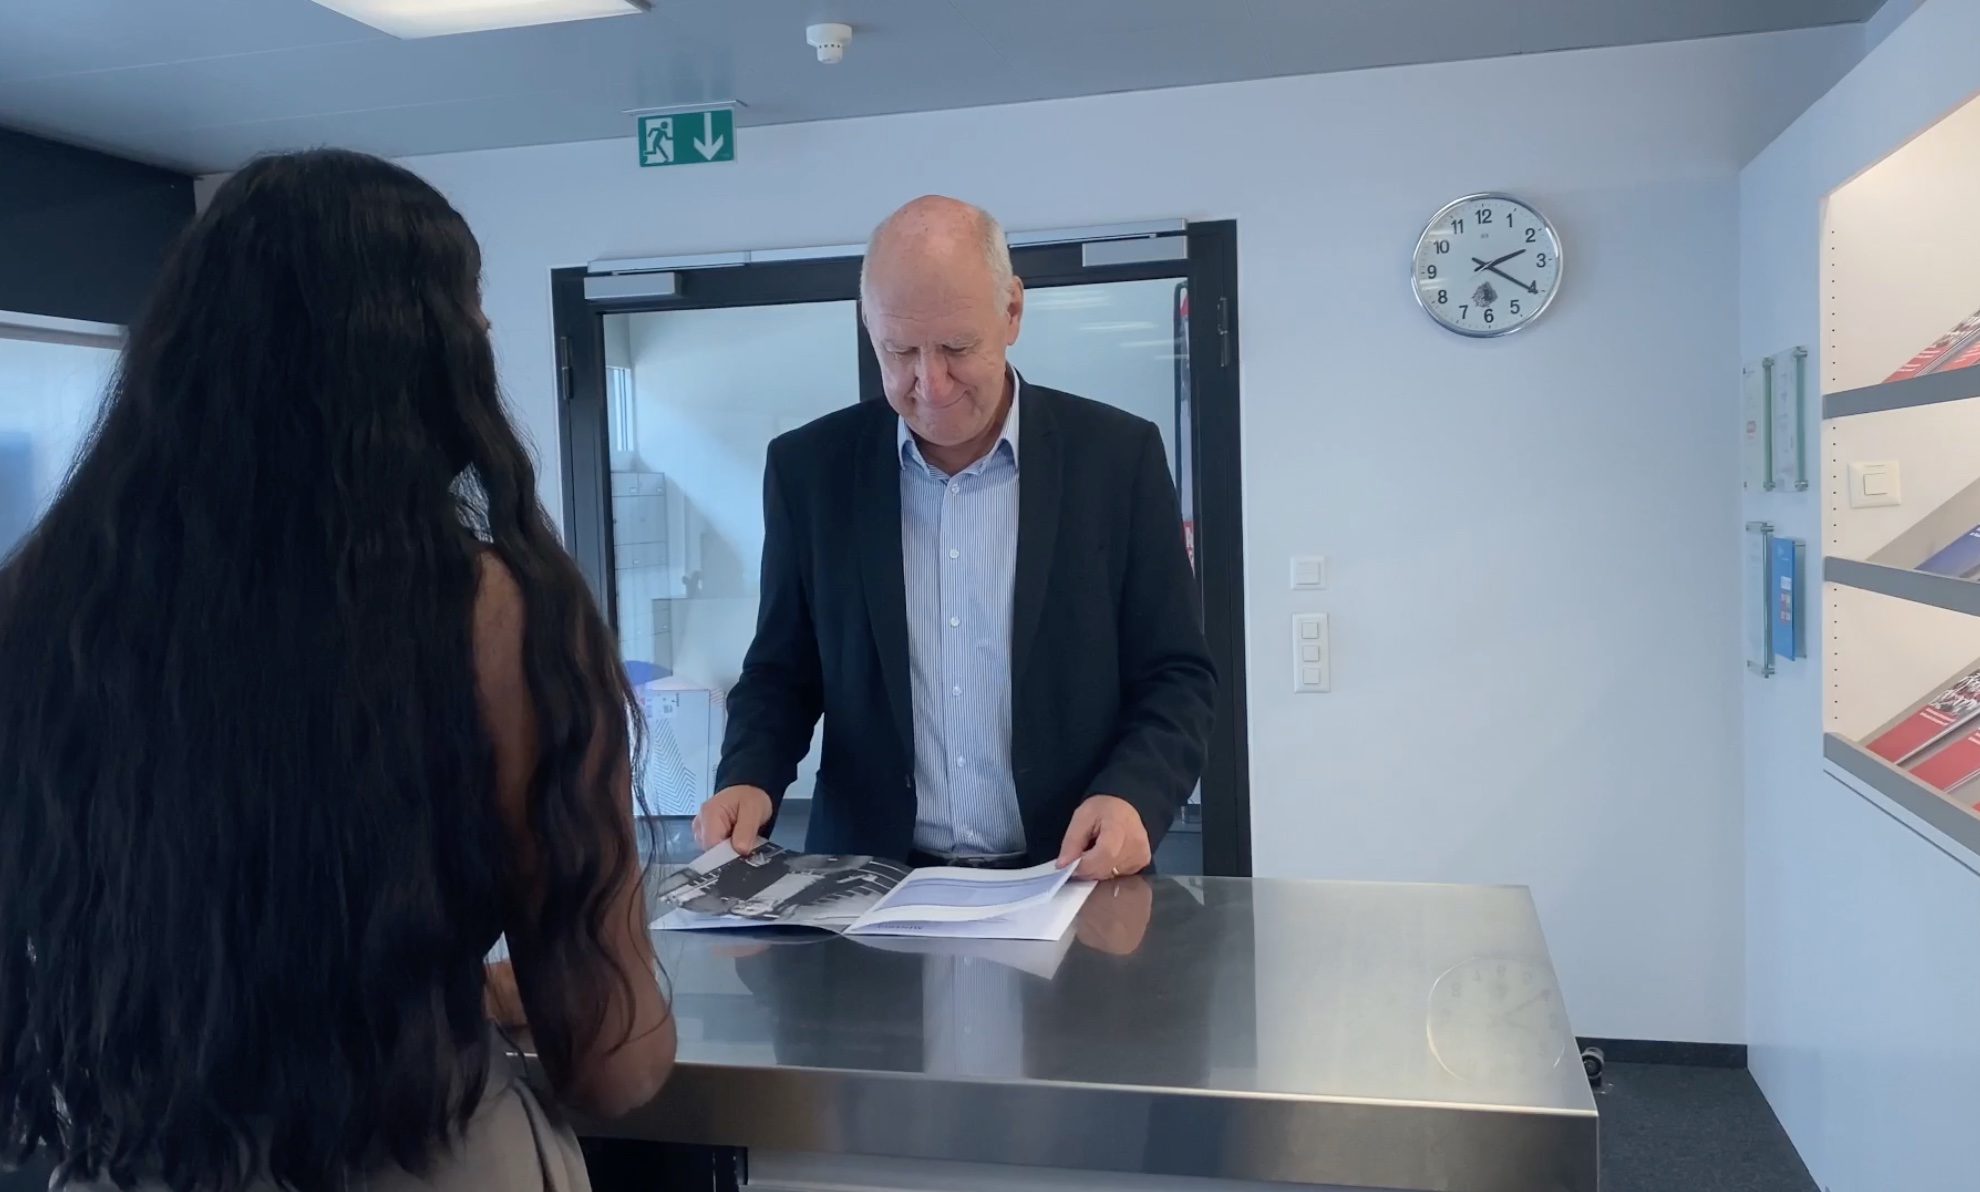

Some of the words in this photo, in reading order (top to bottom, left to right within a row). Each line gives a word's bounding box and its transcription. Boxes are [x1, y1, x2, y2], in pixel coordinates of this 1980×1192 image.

[1475, 208, 1492, 224] 12
[1506, 213, 1513, 228] 1
[1451, 219, 1464, 235] 11
[1525, 228, 1536, 243] 2
[1433, 239, 1450, 254] 10
[1536, 253, 1546, 268] 3
[1427, 265, 1437, 279] 9
[1528, 280, 1538, 294] 4
[1438, 289, 1448, 304] 8
[1459, 305, 1469, 320] 7
[1510, 299, 1520, 314] 5
[1484, 309, 1494, 323] 6
